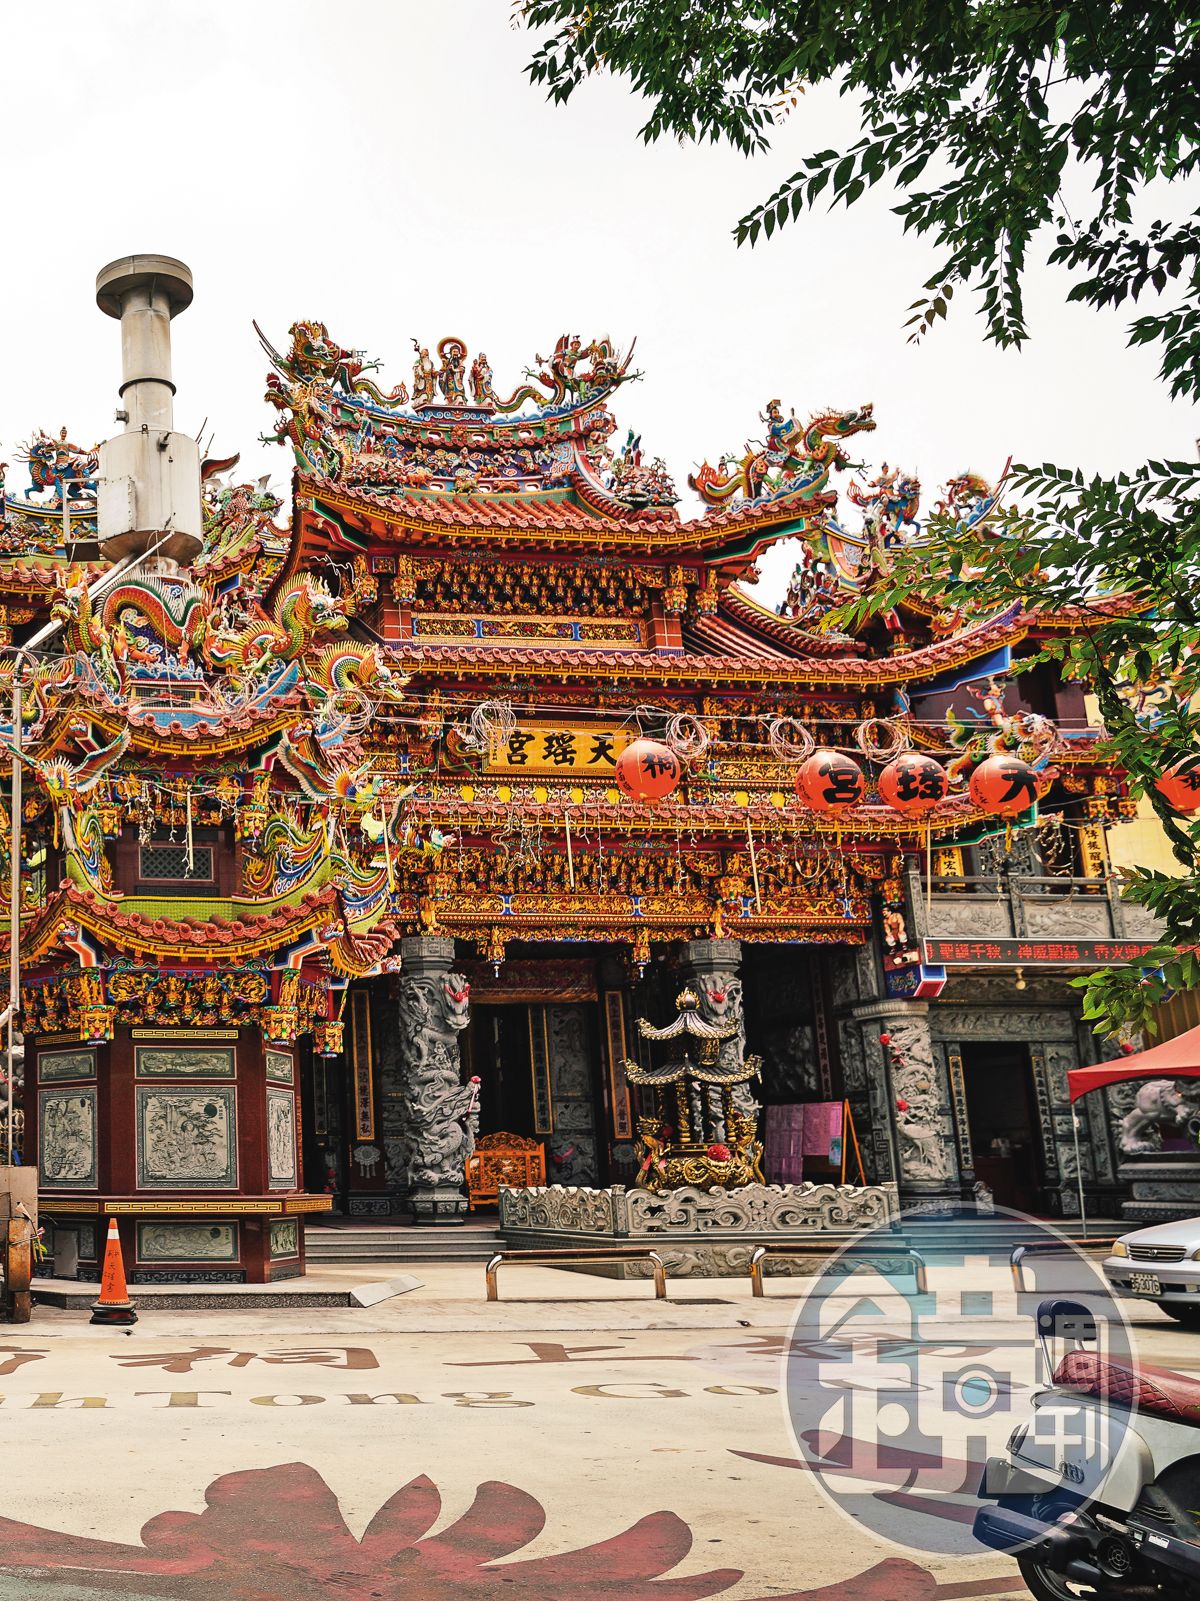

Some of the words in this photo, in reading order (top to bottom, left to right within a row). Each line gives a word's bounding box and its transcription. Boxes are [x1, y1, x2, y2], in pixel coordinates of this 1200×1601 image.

[642, 752, 677, 780] 桐
[818, 757, 863, 804] 宮
[896, 761, 946, 802] 瑤
